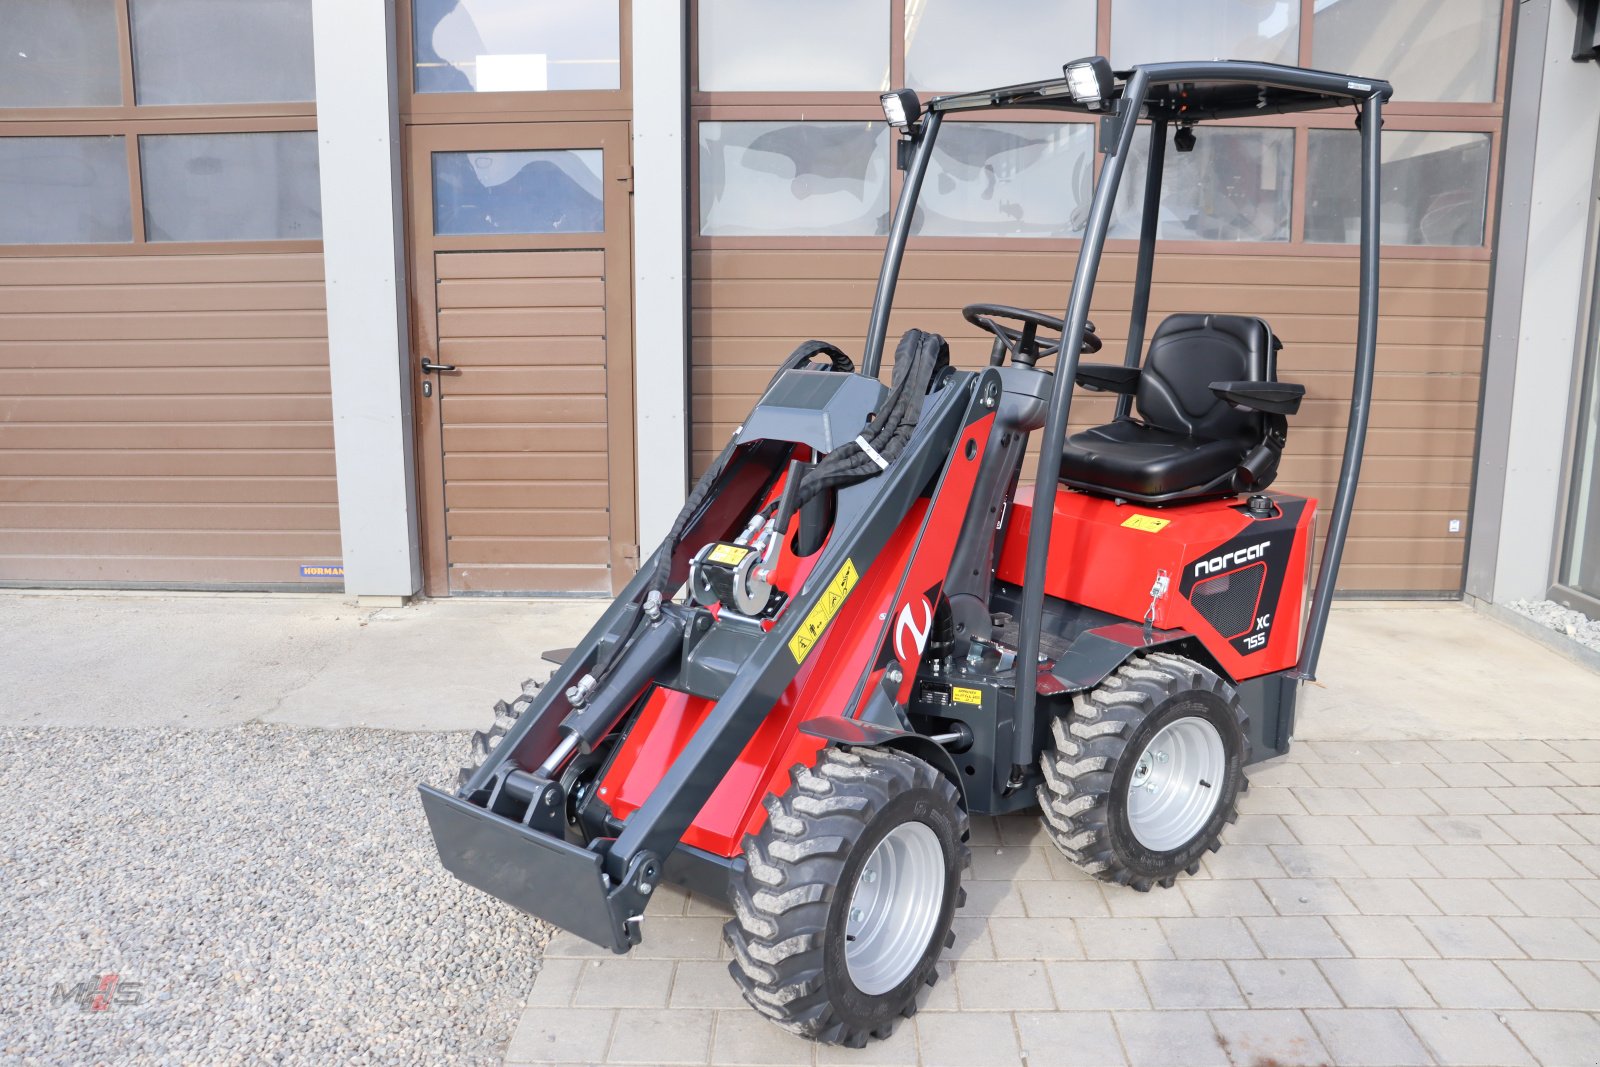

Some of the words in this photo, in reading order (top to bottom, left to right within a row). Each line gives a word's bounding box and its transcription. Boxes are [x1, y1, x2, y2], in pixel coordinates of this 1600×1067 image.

[1195, 541, 1271, 577] norcar
[1256, 614, 1270, 631] XC
[1243, 632, 1265, 650] 755
